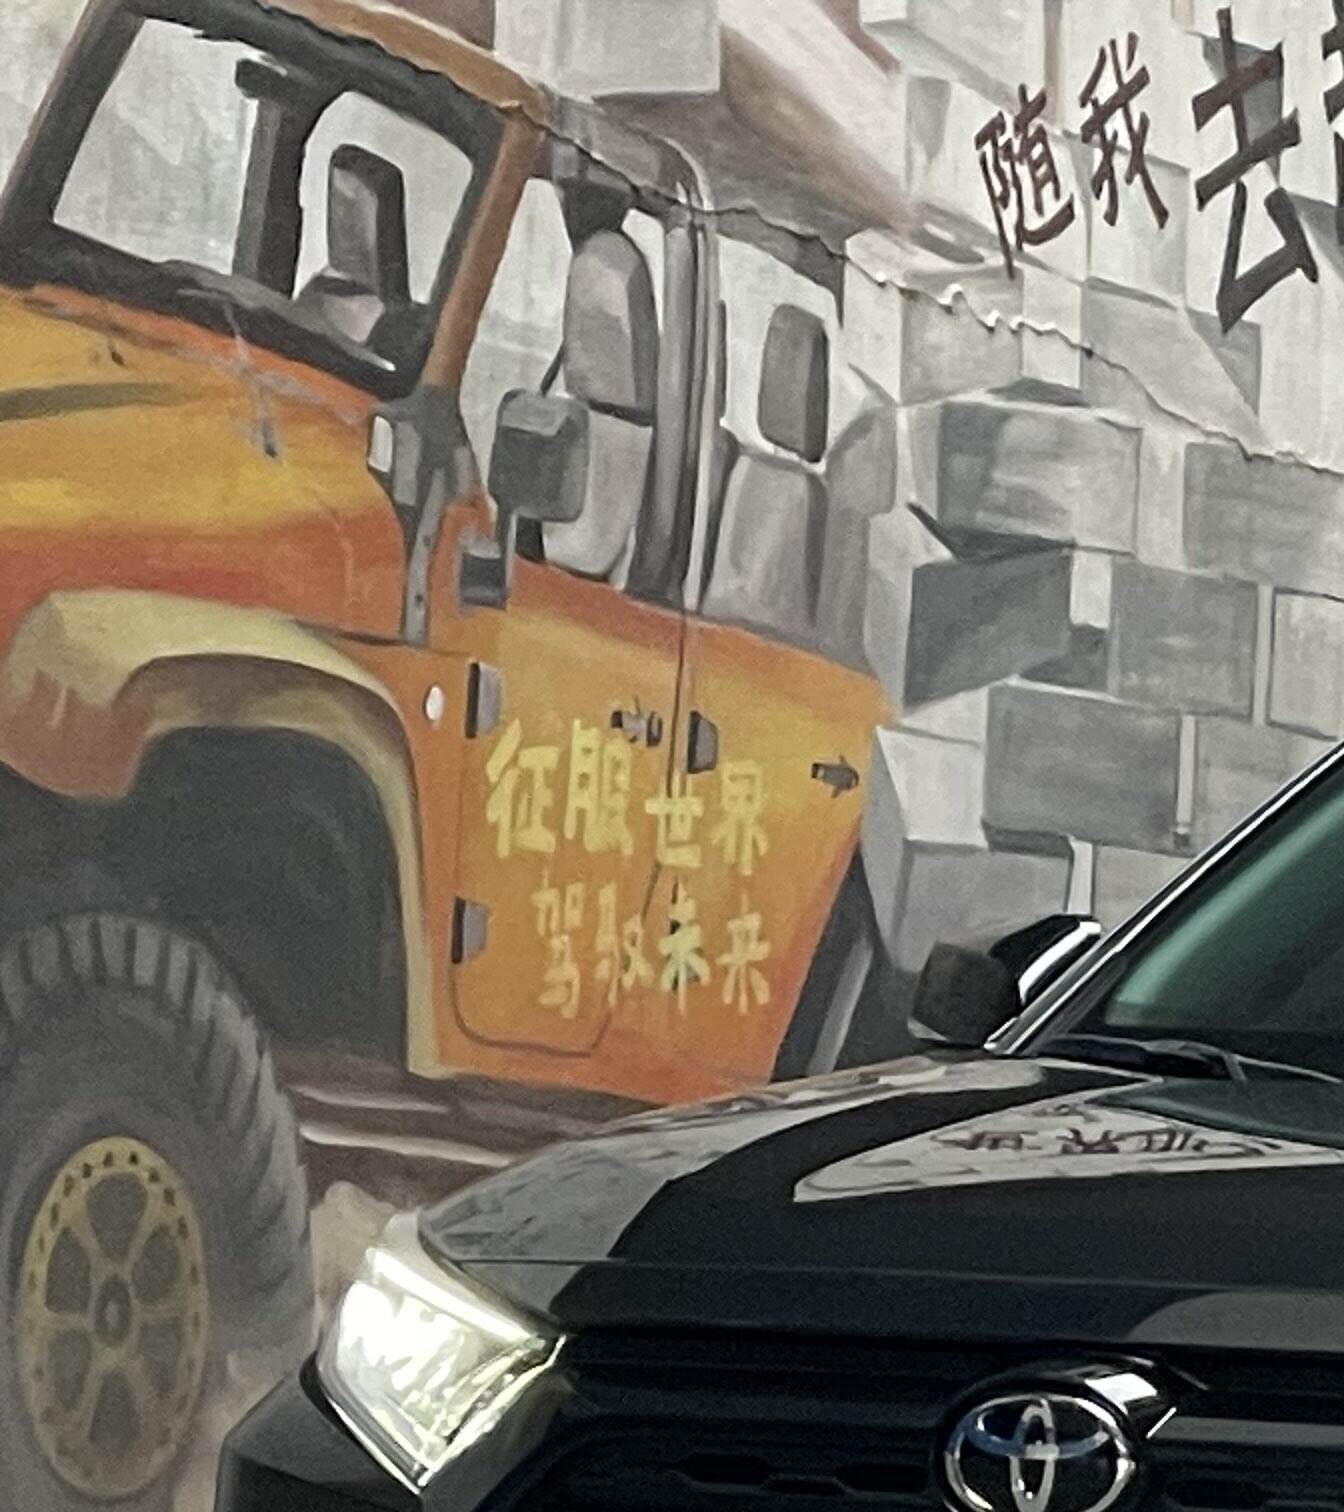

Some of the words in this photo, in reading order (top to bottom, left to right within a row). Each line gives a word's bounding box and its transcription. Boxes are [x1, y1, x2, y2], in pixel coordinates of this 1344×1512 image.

[486, 718, 769, 876] 征服世界
[531, 866, 771, 1019] 驾驭未来
